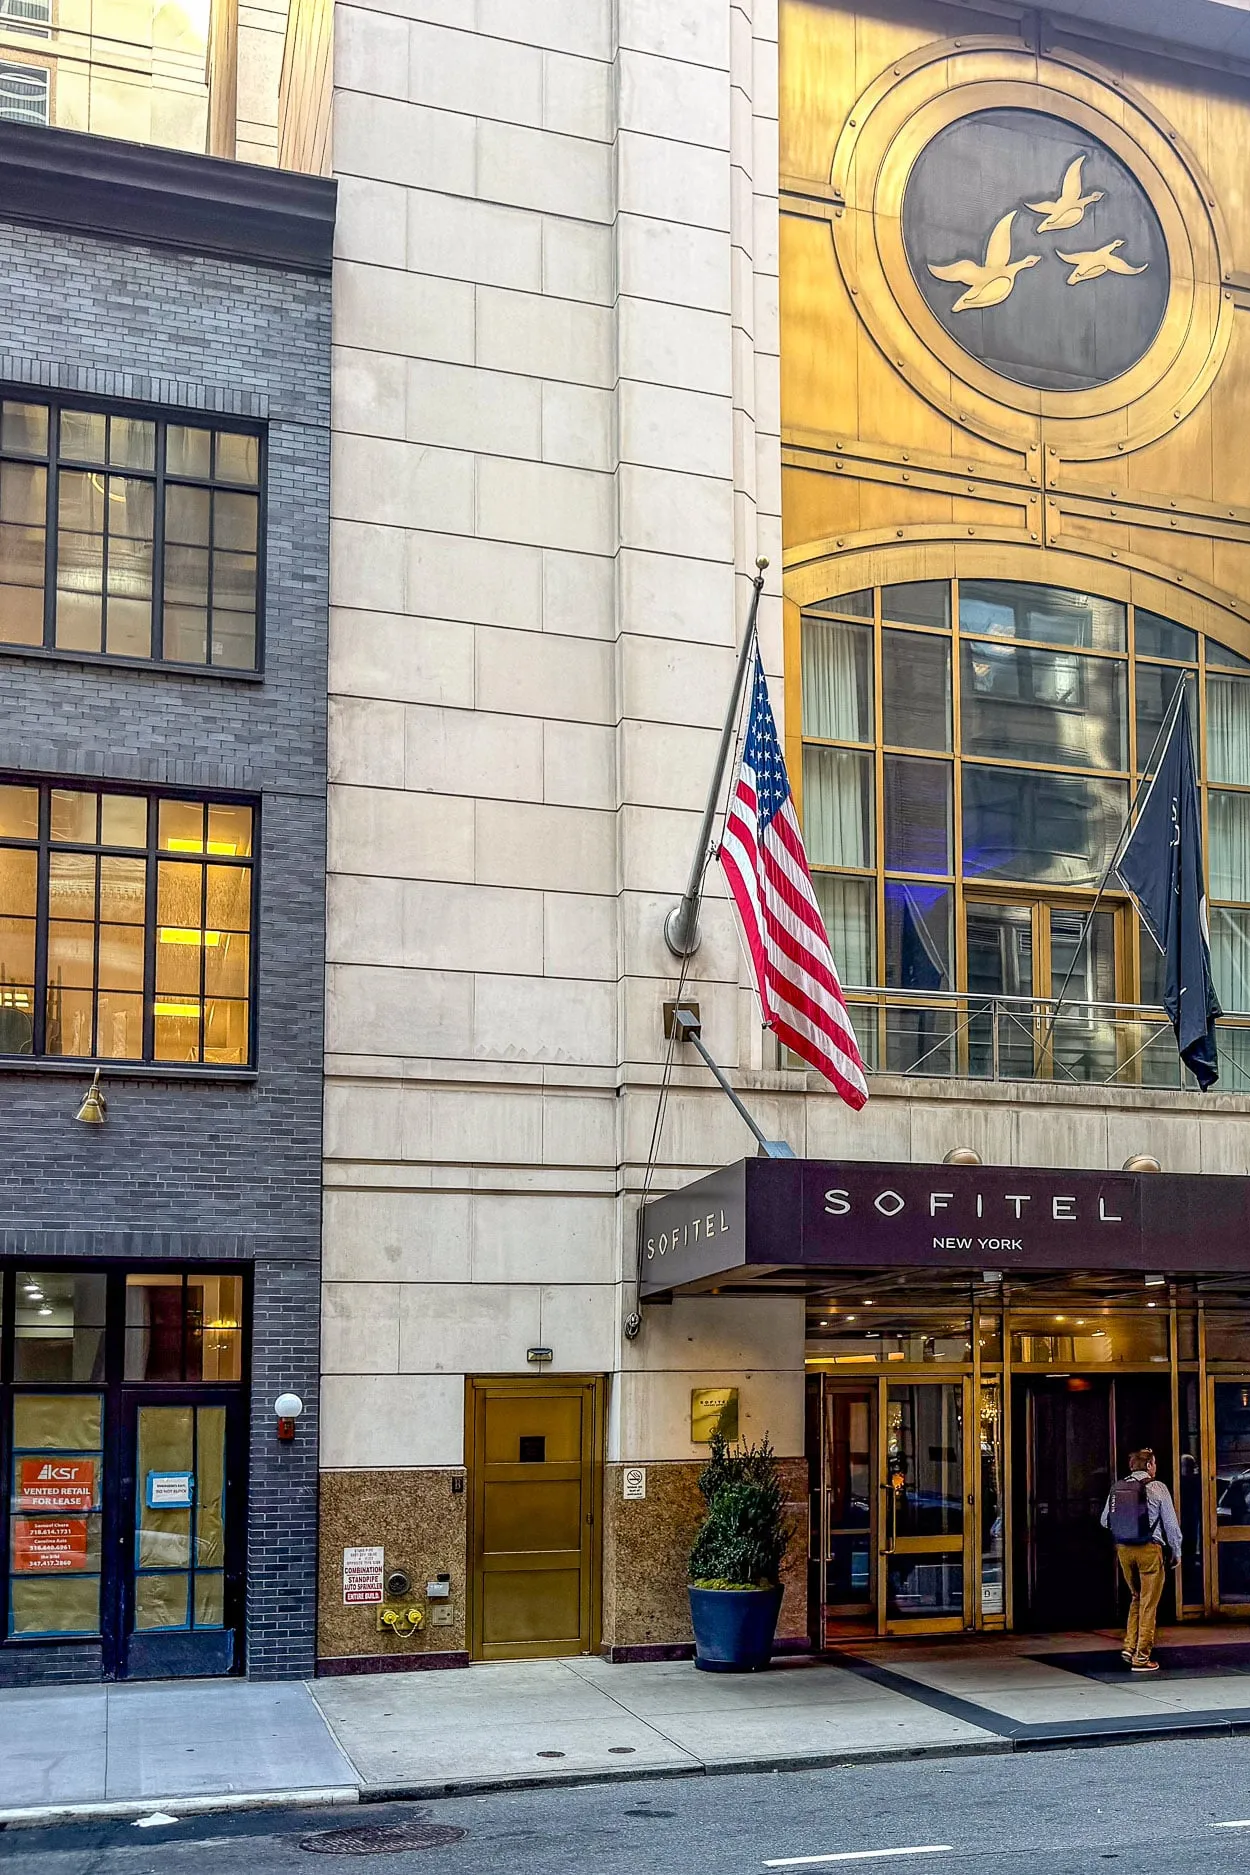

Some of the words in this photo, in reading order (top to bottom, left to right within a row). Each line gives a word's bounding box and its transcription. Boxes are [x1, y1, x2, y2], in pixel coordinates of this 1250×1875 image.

[824, 1188, 1123, 1222] SOFITEL
[646, 1209, 730, 1260] SOFITEL
[932, 1237, 973, 1250] NEW
[977, 1238, 1023, 1251] YORK
[23, 1487, 60, 1495] VENTED
[60, 1487, 91, 1495] RETAIL
[32, 1497, 51, 1505] FOR
[53, 1497, 82, 1505] LEASE
[344, 1566, 383, 1574] COMBINATION
[348, 1575, 379, 1583] STANDPIPE
[357, 1582, 383, 1590] SPRINKLER
